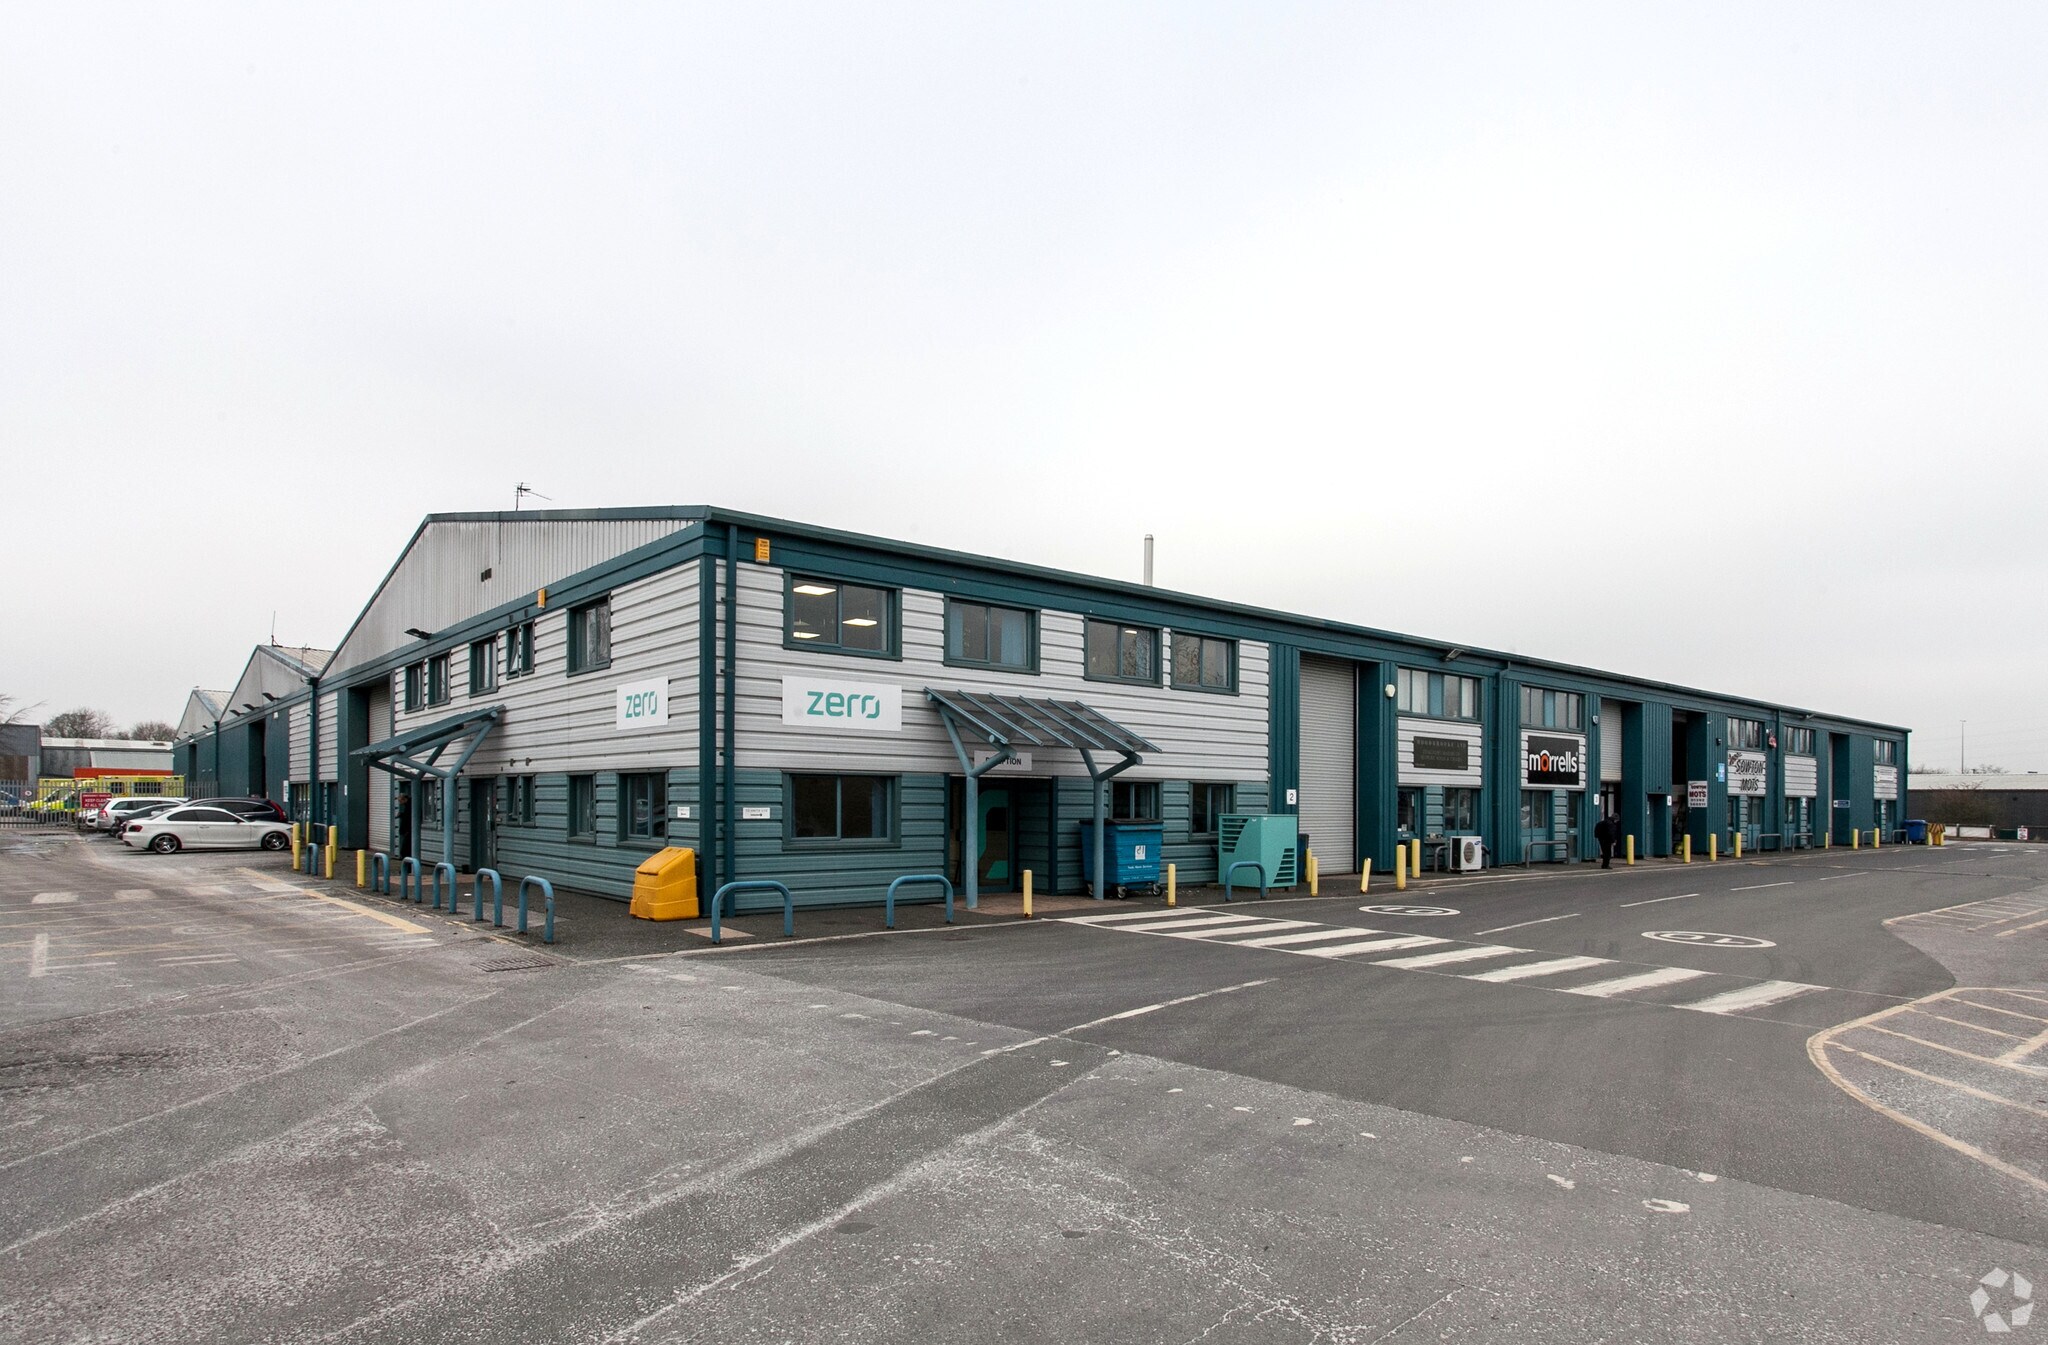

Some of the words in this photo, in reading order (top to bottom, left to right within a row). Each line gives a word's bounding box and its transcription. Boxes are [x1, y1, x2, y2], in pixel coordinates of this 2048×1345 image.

[625, 690, 658, 719] zero
[806, 691, 881, 719] zero
[1529, 749, 1578, 773] morrells
[1736, 758, 1765, 774] SOWTON
[1289, 792, 1294, 802] 2
